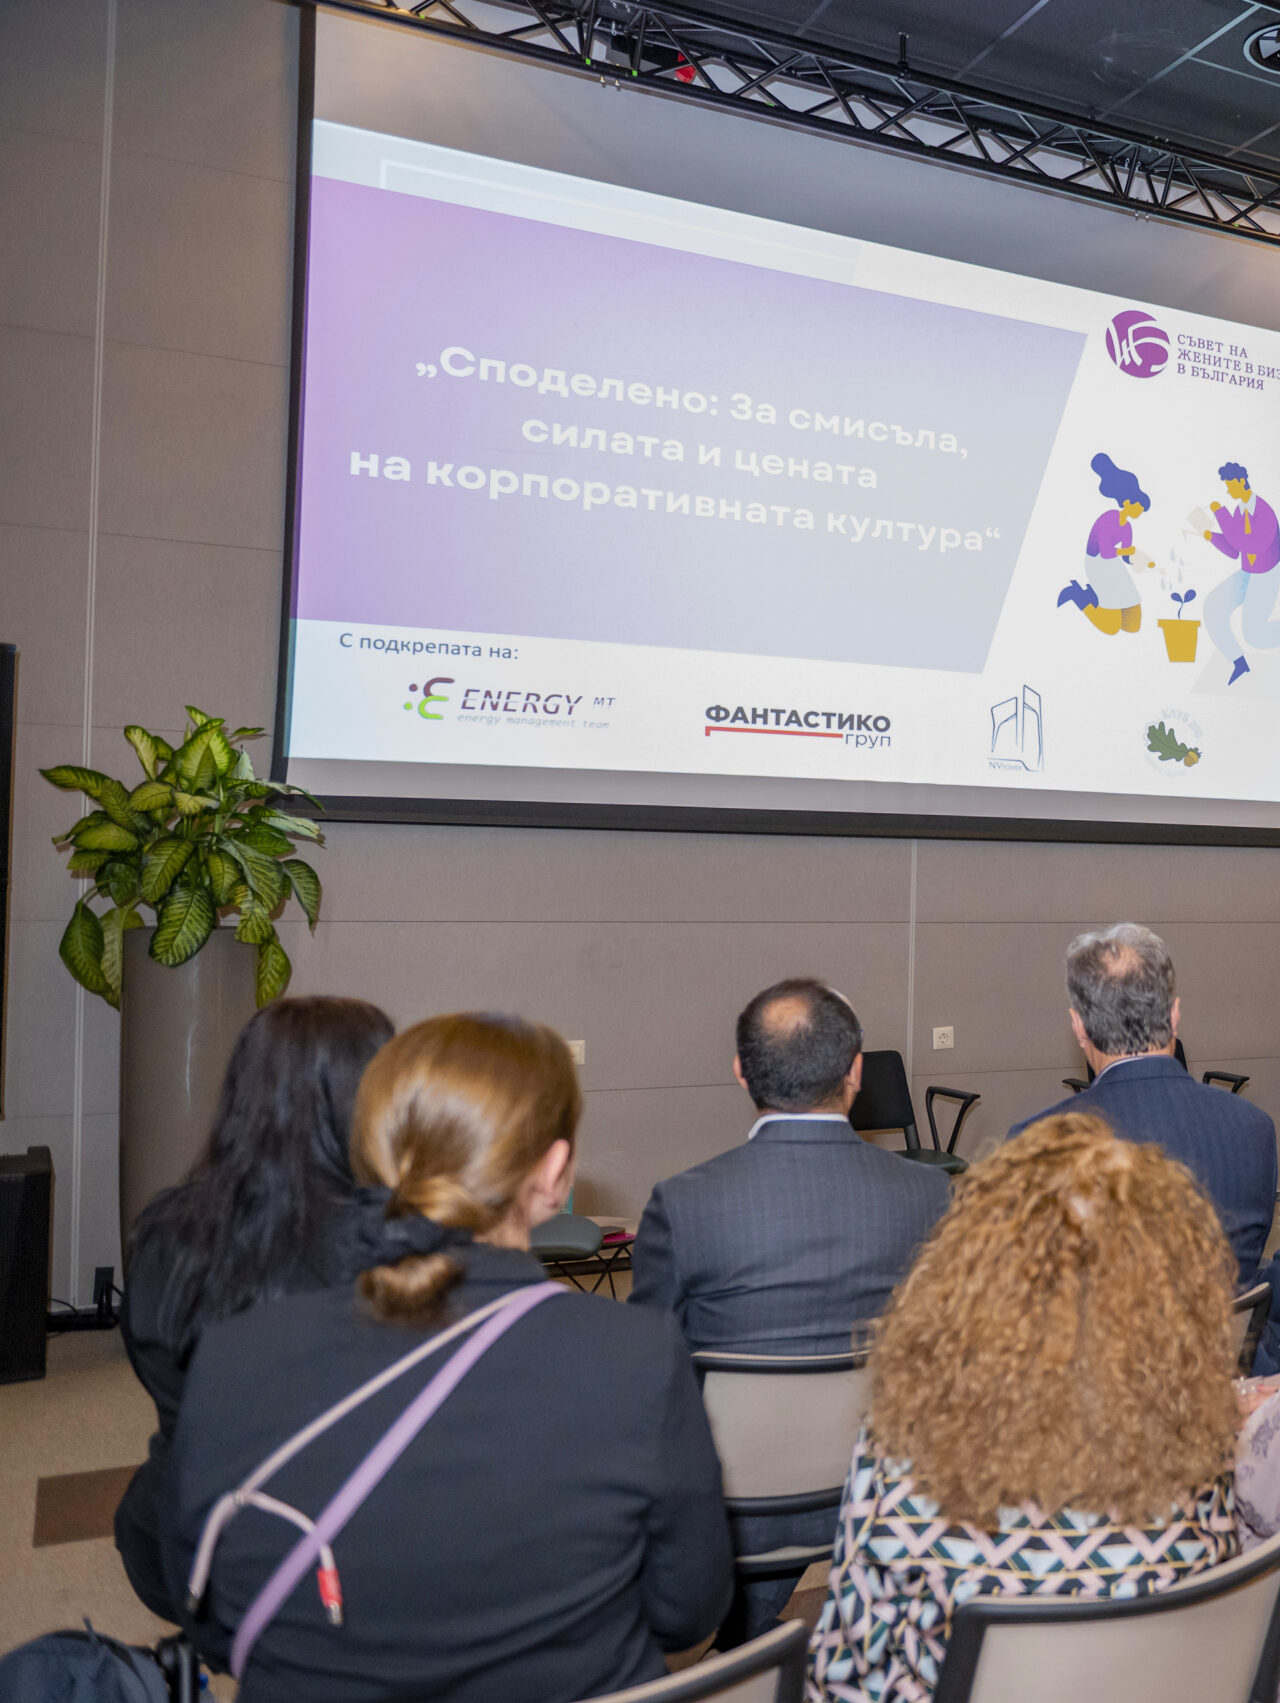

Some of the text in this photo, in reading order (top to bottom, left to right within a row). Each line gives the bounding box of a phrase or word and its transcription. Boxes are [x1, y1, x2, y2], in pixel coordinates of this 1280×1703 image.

[1177, 334, 1248, 358] СЪВЕТ НА
[1177, 348, 1241, 372] ЖЕНИТЕ
[1245, 362, 1254, 374] В
[1177, 363, 1265, 391] В БЪЛГАРИЯ
[729, 398, 778, 426] За
[788, 407, 969, 460] смисъла,
[521, 416, 879, 490] силата и цената
[348, 450, 412, 483] на
[426, 460, 816, 532] корпоративната
[339, 633, 519, 660] С подкрепата на:
[460, 688, 616, 716] ENERGY MT
[457, 713, 610, 729] energy management team
[705, 704, 891, 733] ФАНТАСТИКО
[844, 732, 891, 749] груп
